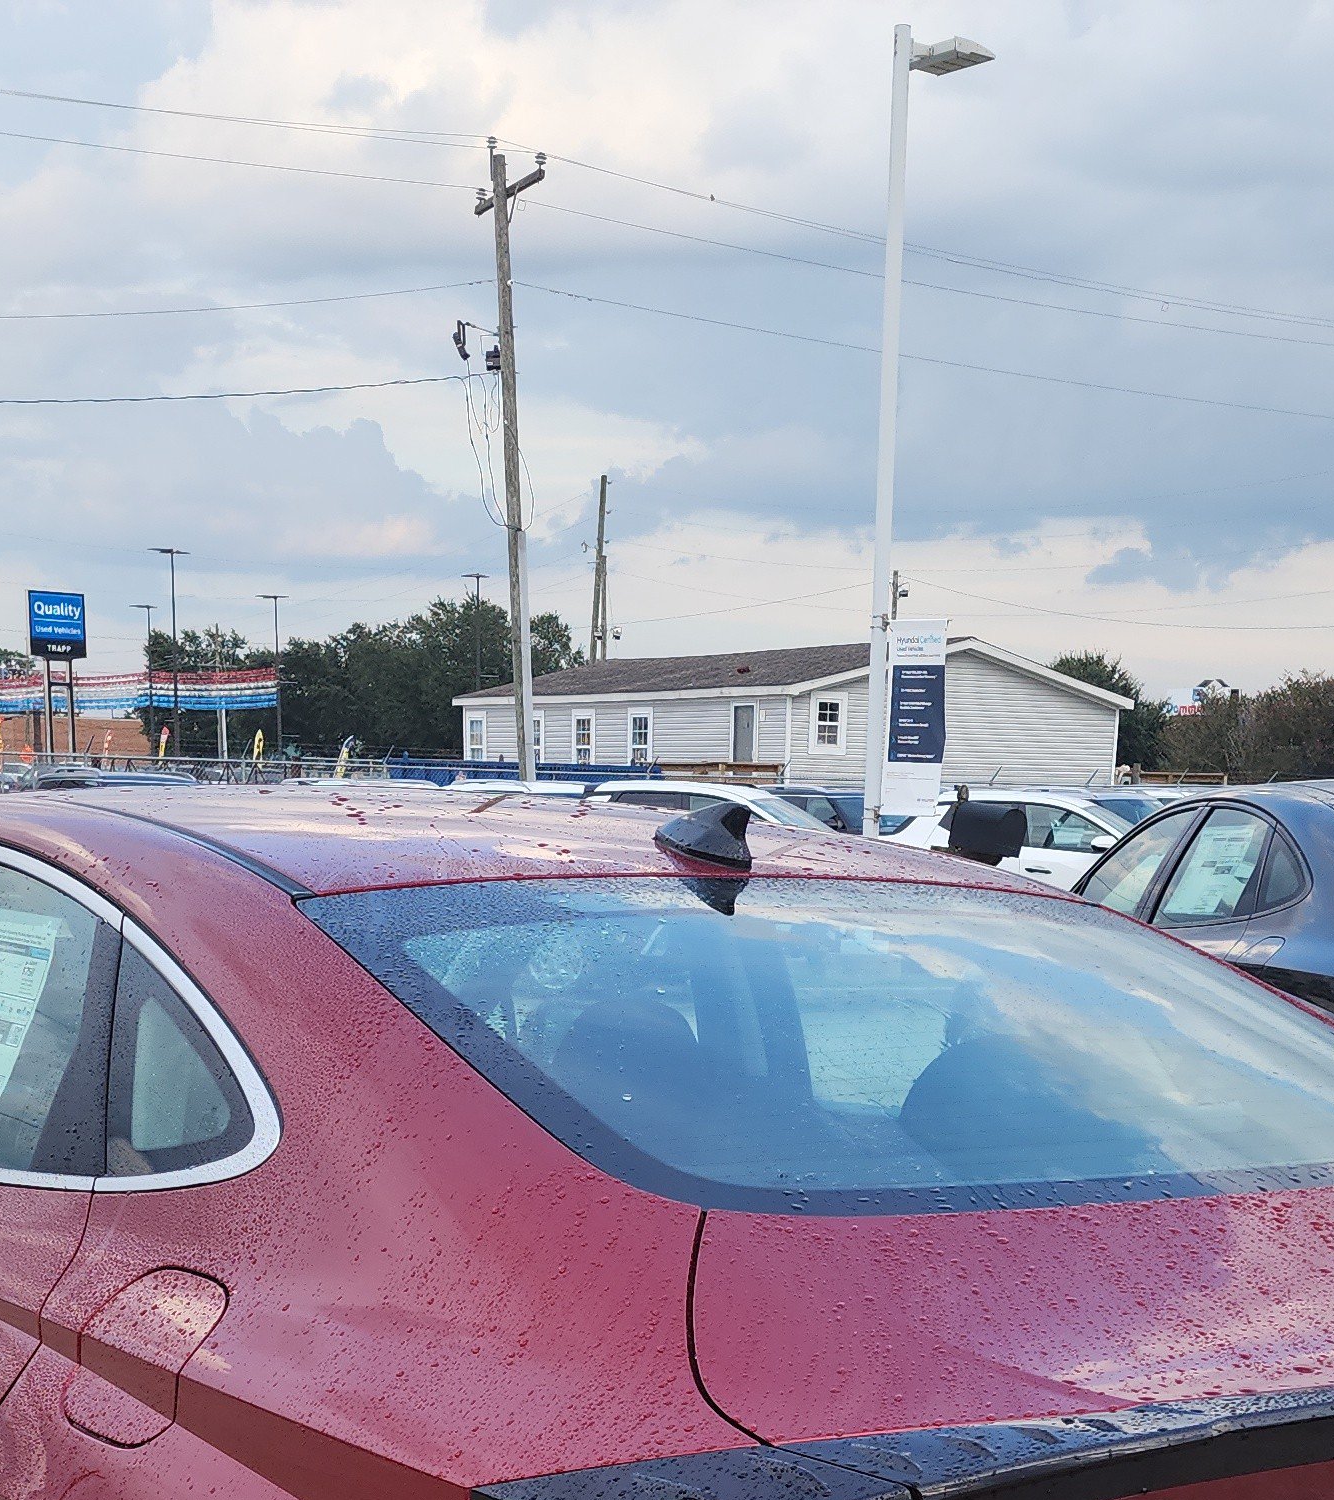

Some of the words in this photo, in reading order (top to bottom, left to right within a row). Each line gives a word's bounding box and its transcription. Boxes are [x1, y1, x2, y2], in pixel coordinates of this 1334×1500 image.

[33, 601, 82, 619] Quality
[35, 625, 52, 633] Used
[54, 626, 81, 635] Vehicles
[896, 636, 919, 645] Hyundai
[46, 644, 72, 652] TRAPP
